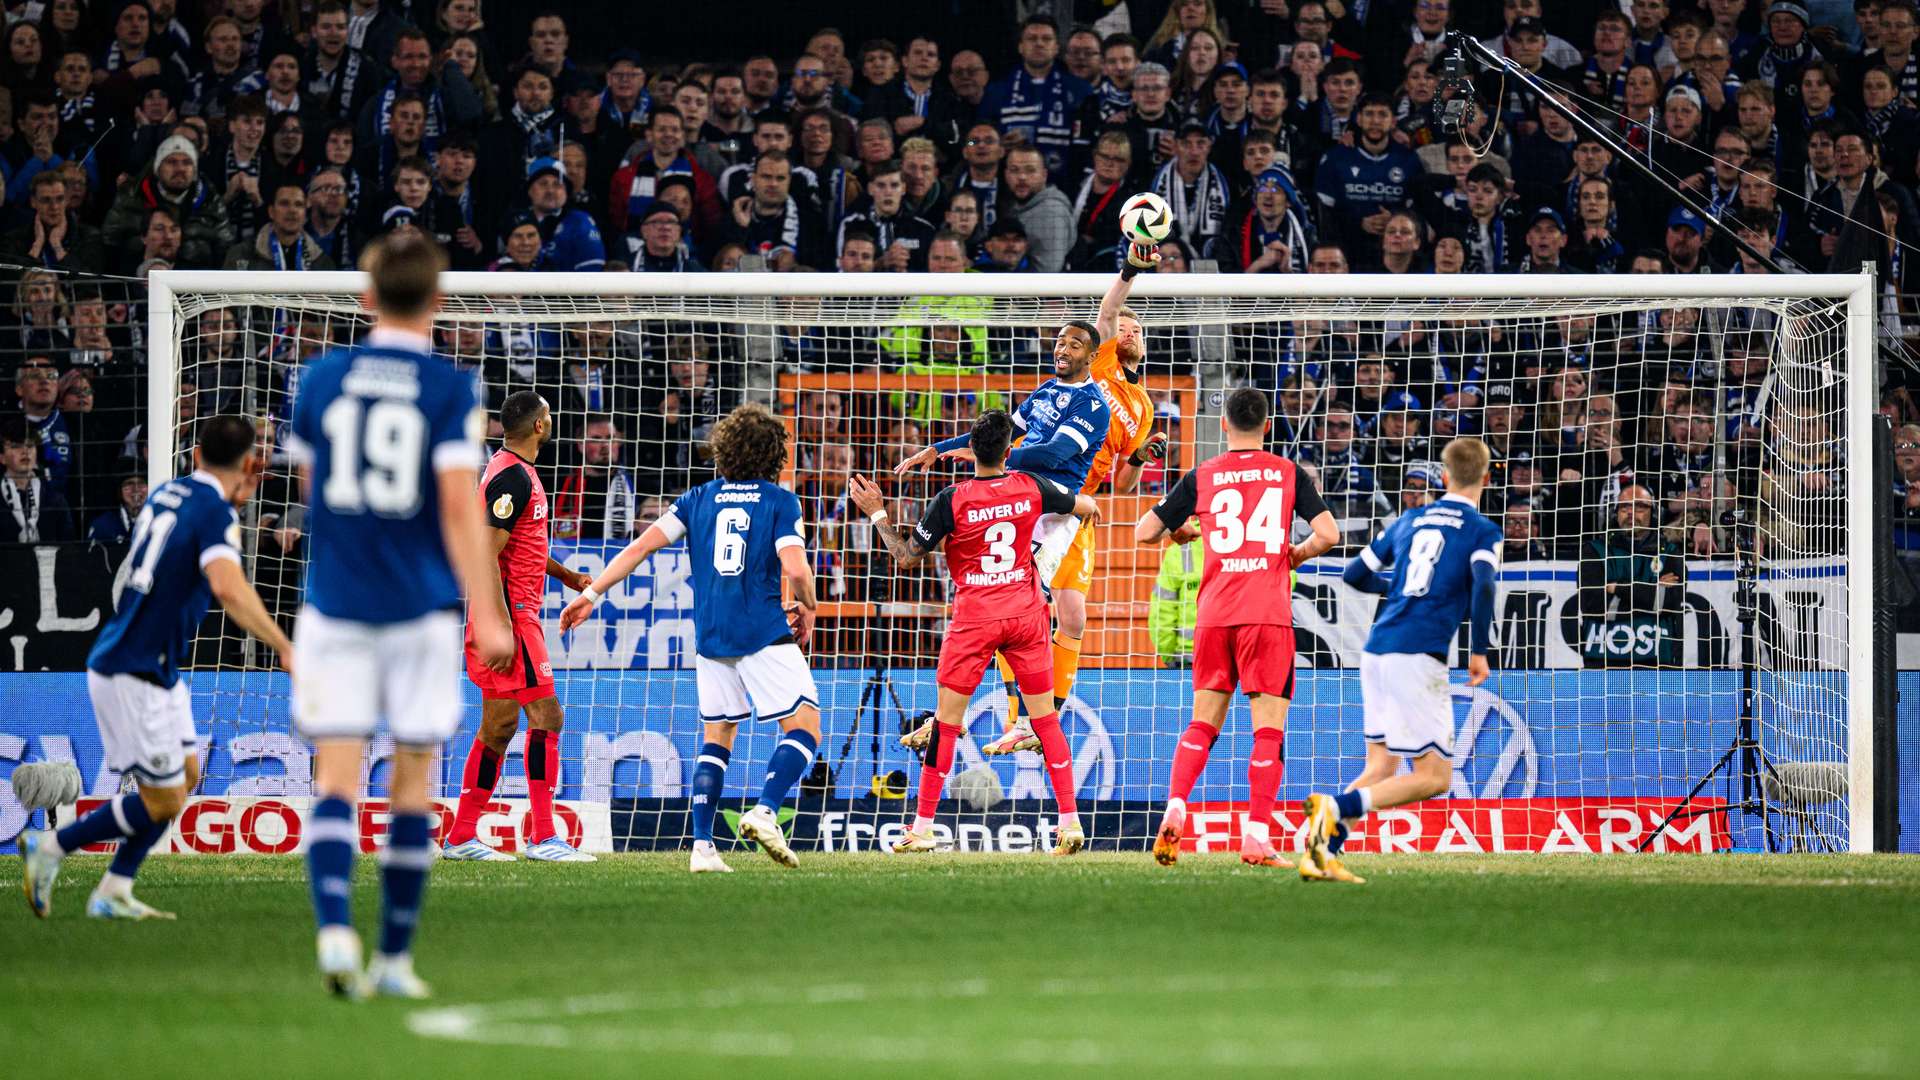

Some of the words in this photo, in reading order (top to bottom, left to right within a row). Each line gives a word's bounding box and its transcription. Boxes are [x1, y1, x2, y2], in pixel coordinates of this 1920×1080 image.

[321, 396, 429, 517] 19
[1212, 469, 1262, 486] BAYER
[1263, 468, 1283, 483] 04
[714, 492, 762, 504] CORBOZ
[967, 503, 1013, 523] BAYER
[1014, 499, 1032, 515] 04
[1209, 487, 1286, 555] 34
[713, 507, 751, 576] 6
[980, 521, 1017, 574] 3
[1220, 557, 1269, 573] XHAKA
[1402, 528, 1445, 598] 8
[1585, 622, 1669, 657] HOST
[76, 799, 303, 855] EGO
[1192, 808, 1714, 854] FYERALARM
